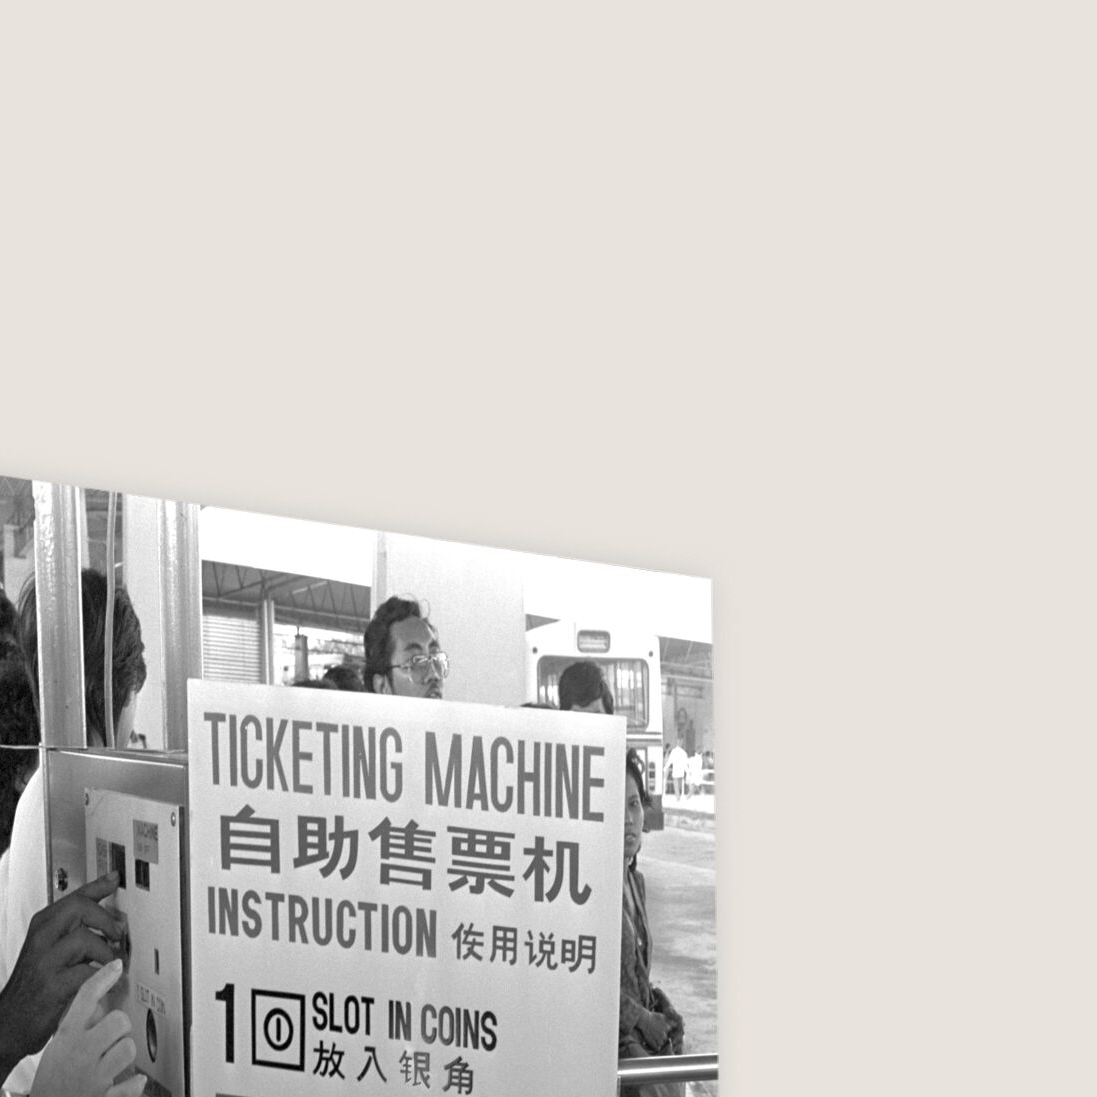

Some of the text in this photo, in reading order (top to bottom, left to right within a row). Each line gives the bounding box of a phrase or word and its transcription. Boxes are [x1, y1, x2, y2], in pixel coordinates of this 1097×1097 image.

[204, 712, 606, 822] TICKETING MACHINE
[219, 804, 593, 905] 自助售票机
[207, 886, 438, 958] INSTRUCTION
[214, 983, 236, 1064] 1
[312, 991, 499, 1052] SLOT IN COINS
[312, 1039, 475, 1095] 放入银角
